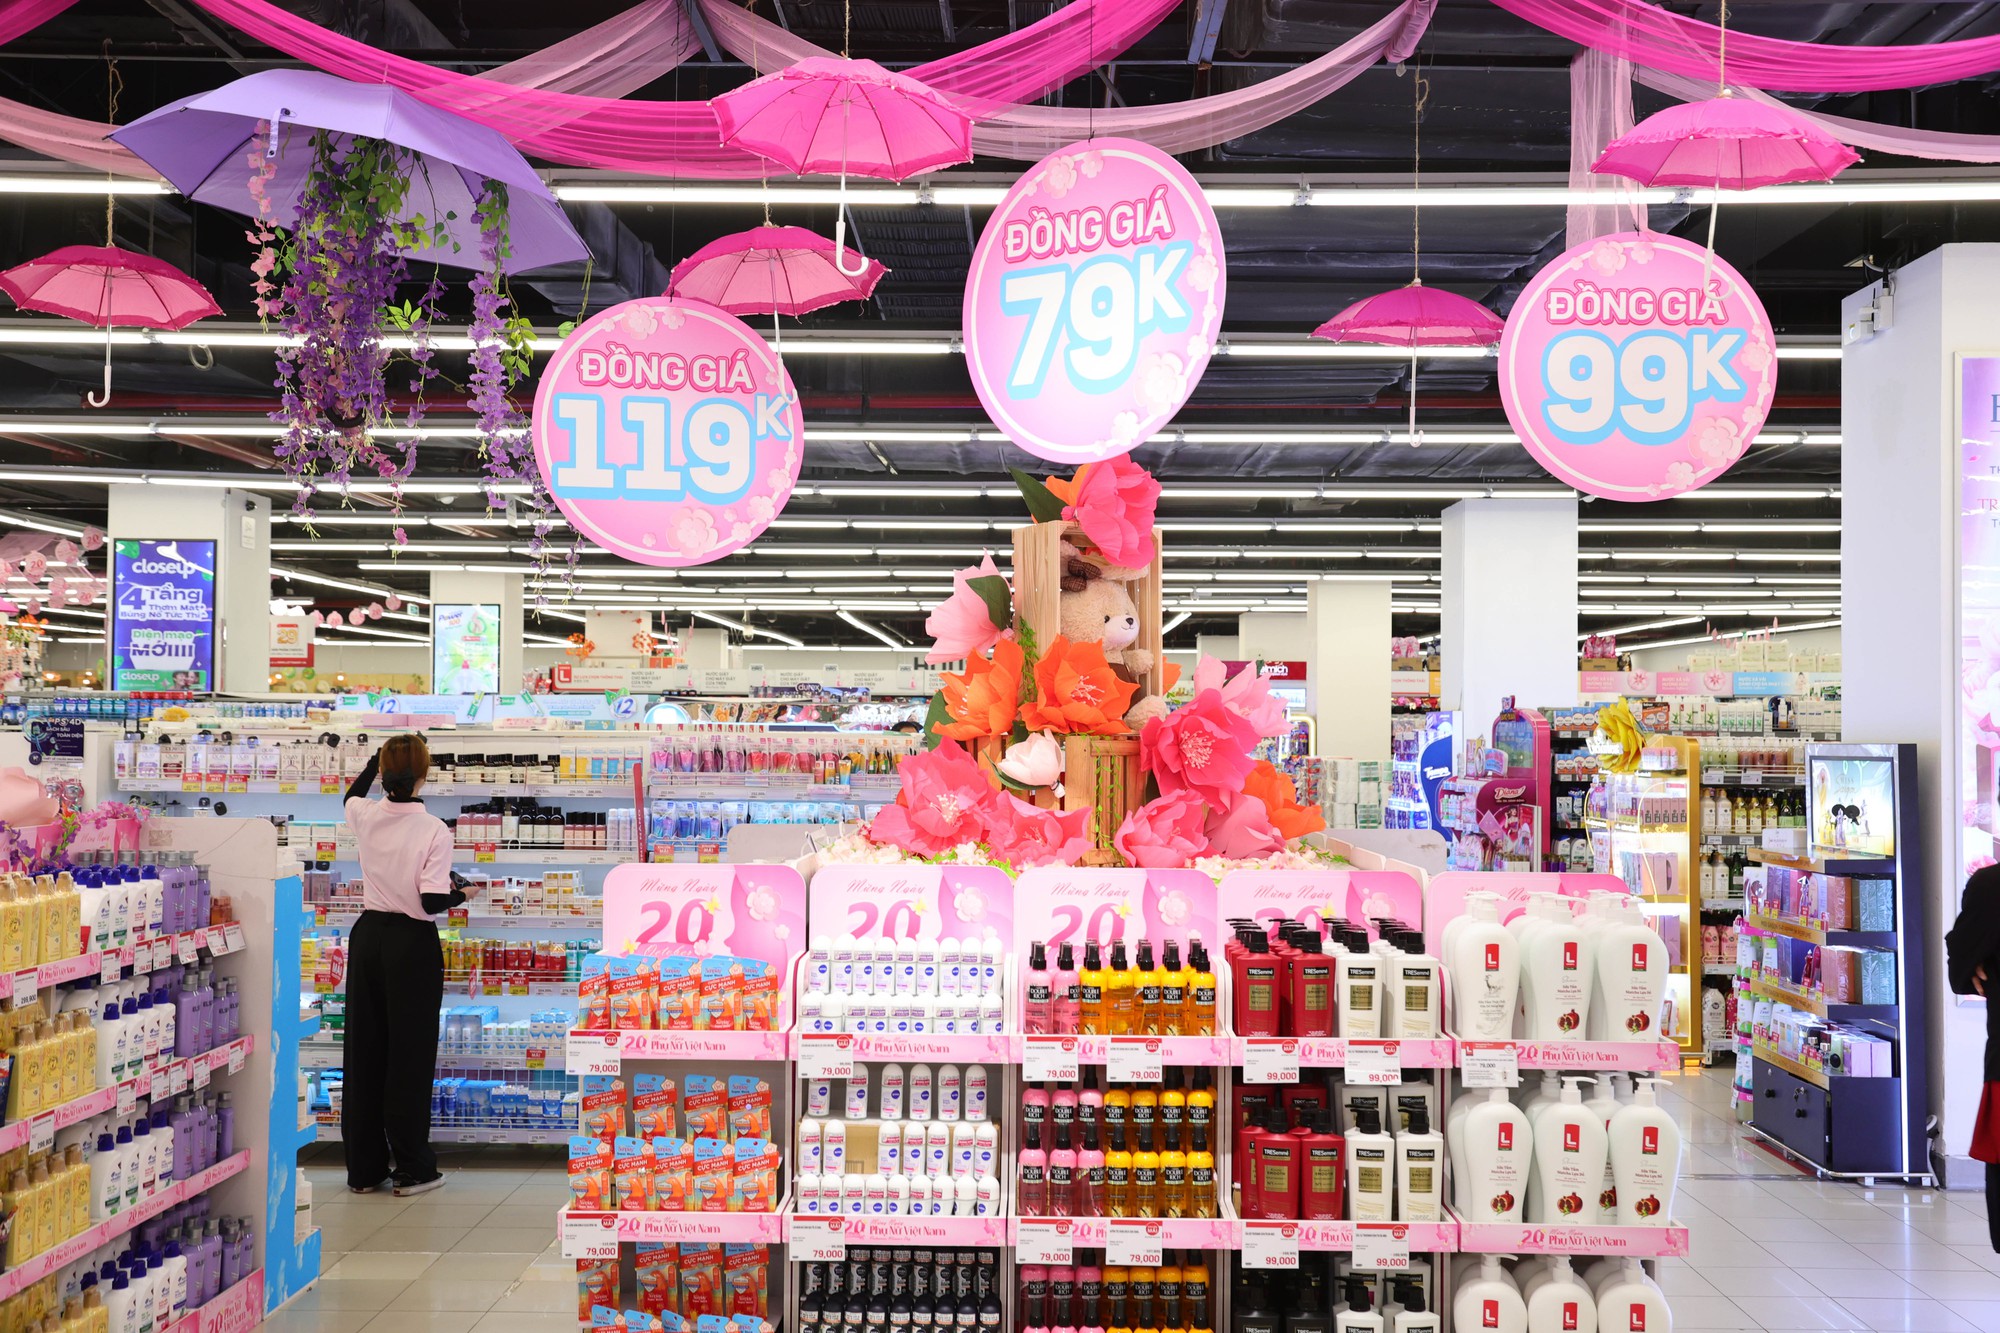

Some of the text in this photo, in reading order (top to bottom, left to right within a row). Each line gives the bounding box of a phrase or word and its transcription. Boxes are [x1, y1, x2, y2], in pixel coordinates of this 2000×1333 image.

[1004, 186, 1173, 260] ĐỒNG GIÁ
[1546, 280, 1727, 324] ĐỒNG GIÁ
[1002, 242, 1192, 396] 79K
[580, 344, 756, 391] ĐỒNG GIÁ
[1543, 330, 1746, 442] 99K
[554, 394, 791, 501] 119K
[132, 559, 196, 578] closeup
[121, 583, 200, 610] 4 Tầng
[133, 630, 193, 641] Diện mạo
[277, 630, 298, 644] 29
[121, 672, 160, 682] closeup
[560, 671, 570, 681] L
[798, 684, 821, 692] durex
[380, 699, 396, 713] 12
[615, 698, 634, 714] 12
[1496, 787, 1520, 798] Diana
[640, 878, 719, 892] Mừng Ngày
[847, 879, 926, 894] Mừng Ngày
[1051, 882, 1130, 897] Mừng Ngày
[1253, 885, 1333, 900] Mừng Ngày
[636, 898, 714, 945] 20
[848, 900, 921, 945] 20
[1045, 903, 1125, 949] 20
[643, 944, 693, 957] October
[1487, 953, 1497, 965] L
[1565, 952, 1575, 963] L
[1635, 953, 1645, 965] L
[1030, 987, 1049, 995] DOUBLE
[651, 1040, 726, 1052] Phụ Nữ Việt Nam
[837, 1039, 849, 1047] MÃI
[874, 1041, 950, 1053] Phụ Việt Nam
[1517, 1045, 1538, 1059] 20
[1542, 1051, 1619, 1062] Phụ Nữ Việt Nam
[589, 1065, 618, 1073] 79,000
[821, 1067, 851, 1076] 79,000
[1047, 1070, 1076, 1079] 79,000
[1130, 1071, 1160, 1080] 79,000
[1267, 1072, 1297, 1081] 99,000
[1369, 1073, 1399, 1083] 99,000
[586, 1098, 600, 1106] CỰC
[637, 1097, 651, 1106] CỰC
[1500, 1131, 1511, 1144] L
[1566, 1133, 1576, 1145] L
[586, 1159, 603, 1167] MẠNH
[752, 1159, 770, 1168] MẠNH
[644, 1223, 720, 1235] Phụ Nữ Việt Nam
[829, 1221, 841, 1230] MÃI
[869, 1225, 946, 1238] Phụ Nữ Việt Nam
[1522, 1229, 1545, 1244] 20
[1548, 1235, 1627, 1247] Phụ Nữ Việt Nam
[586, 1248, 616, 1257] 79,000
[813, 1249, 843, 1259] 79,000
[1040, 1253, 1070, 1262] 79,000
[1265, 1257, 1296, 1266] 99,000
[1376, 1258, 1407, 1268] 99,000
